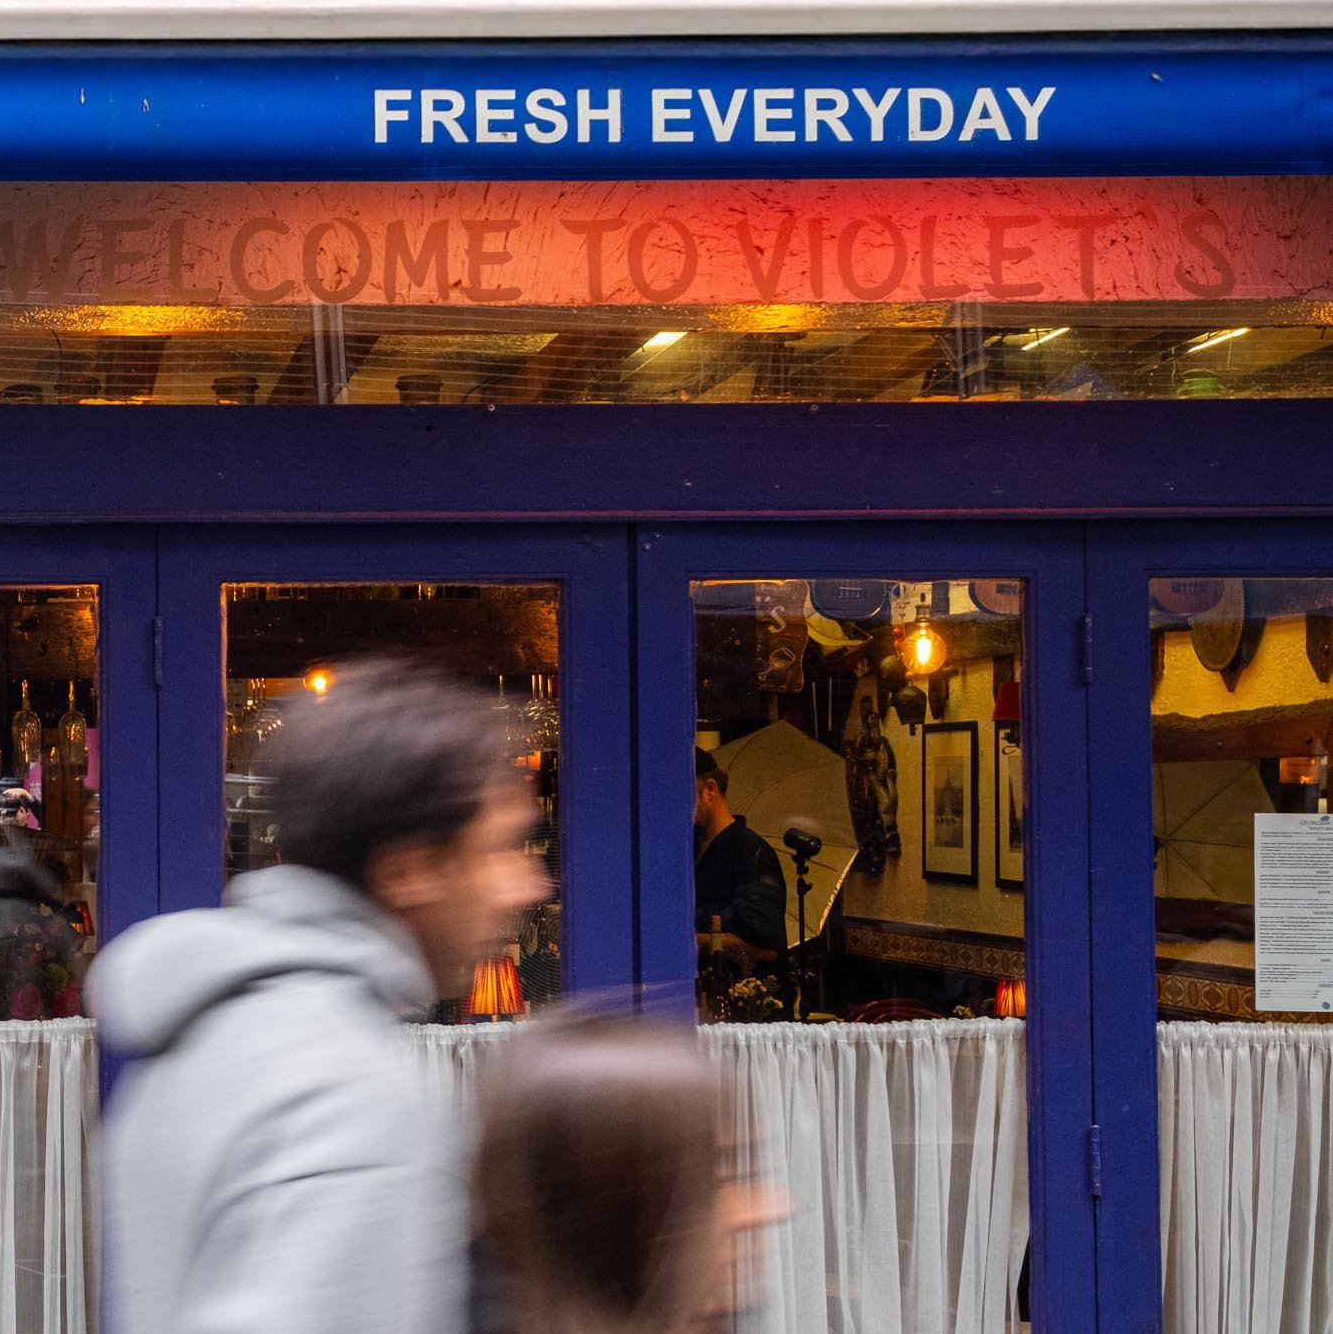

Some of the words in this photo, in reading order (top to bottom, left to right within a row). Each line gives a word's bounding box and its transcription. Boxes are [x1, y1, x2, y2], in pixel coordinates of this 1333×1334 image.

[374, 88, 622, 144] FRESH
[651, 86, 1056, 143] EVERYDAY
[561, 217, 699, 302] TO
